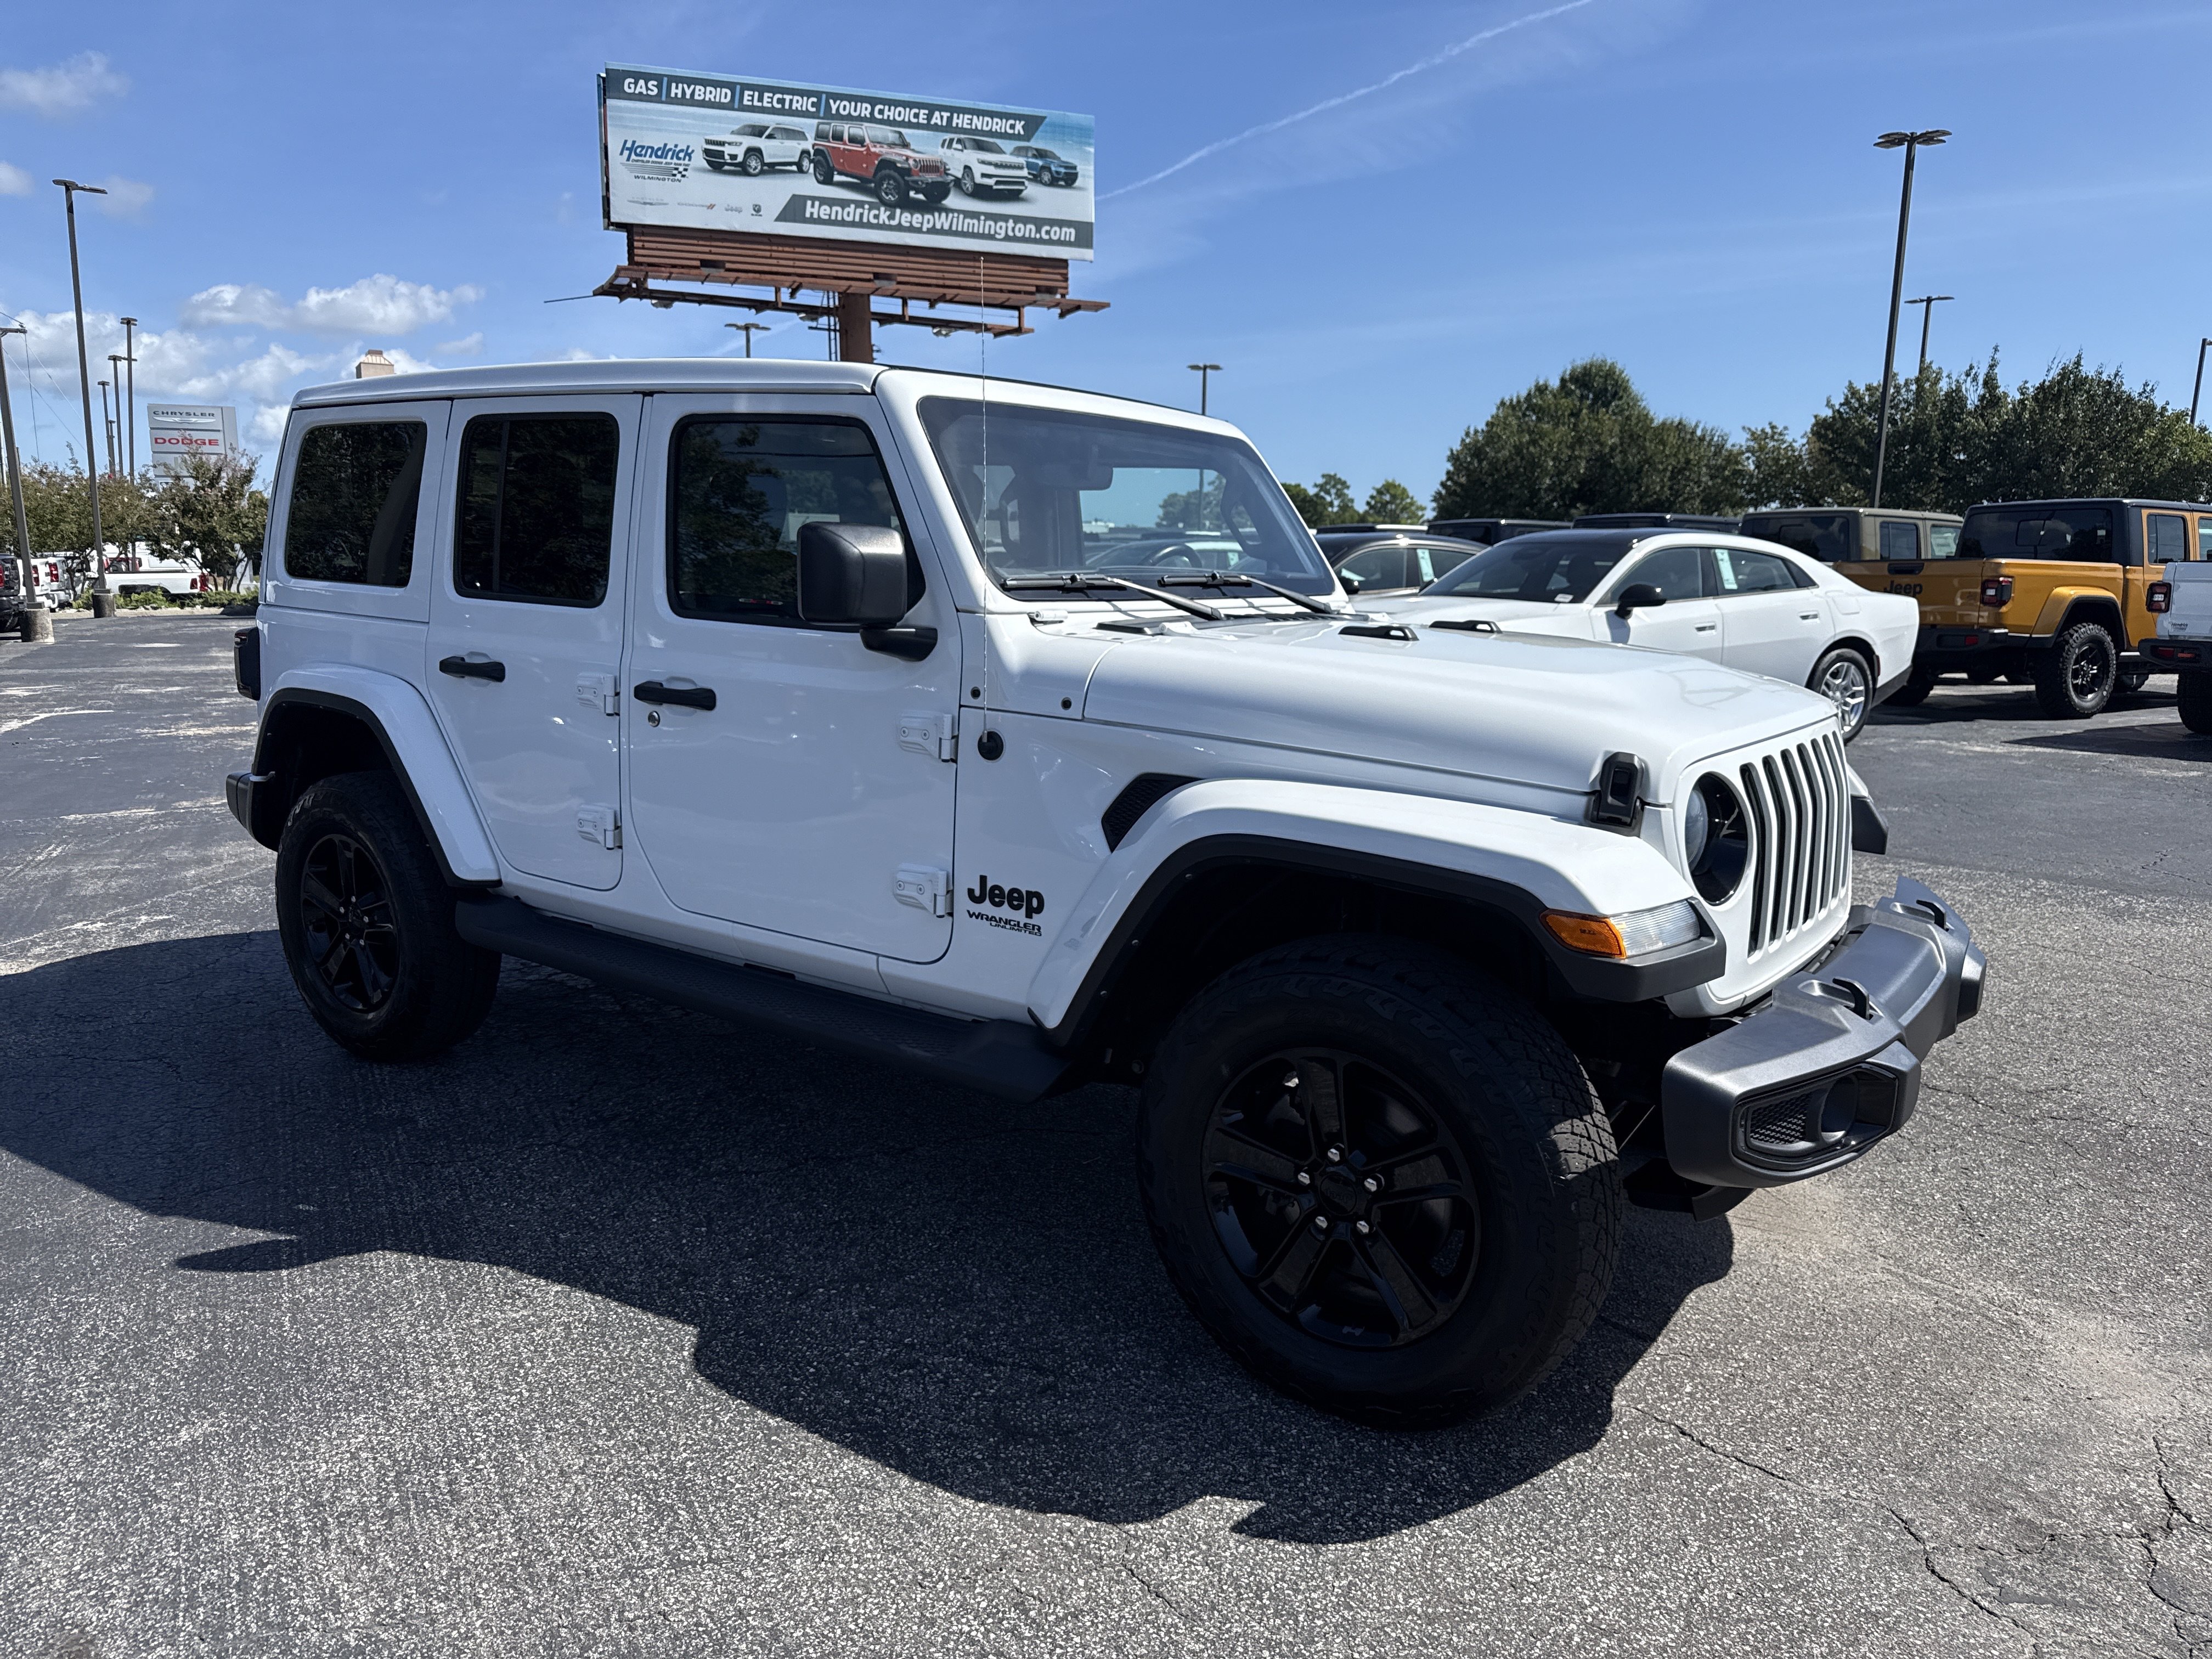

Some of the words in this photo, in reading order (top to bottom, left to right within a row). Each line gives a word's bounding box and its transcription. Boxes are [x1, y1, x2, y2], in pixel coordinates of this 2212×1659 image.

[624, 78, 658, 95] GAS
[670, 83, 731, 103] HYBRID
[743, 91, 817, 112] ELECTRIC
[829, 99, 871, 119] YOUR
[874, 104, 928, 125] CHOICE
[930, 112, 950, 127] AT
[952, 114, 1025, 135] HENDRICK
[619, 139, 695, 162] Hendrick
[634, 174, 681, 183] WILMINGTON
[805, 200, 1076, 241] HendrickJeepWilmington.com
[154, 437, 219, 446] DODGE
[1883, 579, 1923, 597] Jeep
[967, 874, 1045, 919] Jeep
[966, 909, 1042, 933] WRANGLER
[990, 922, 1042, 936] UNLIMITED
